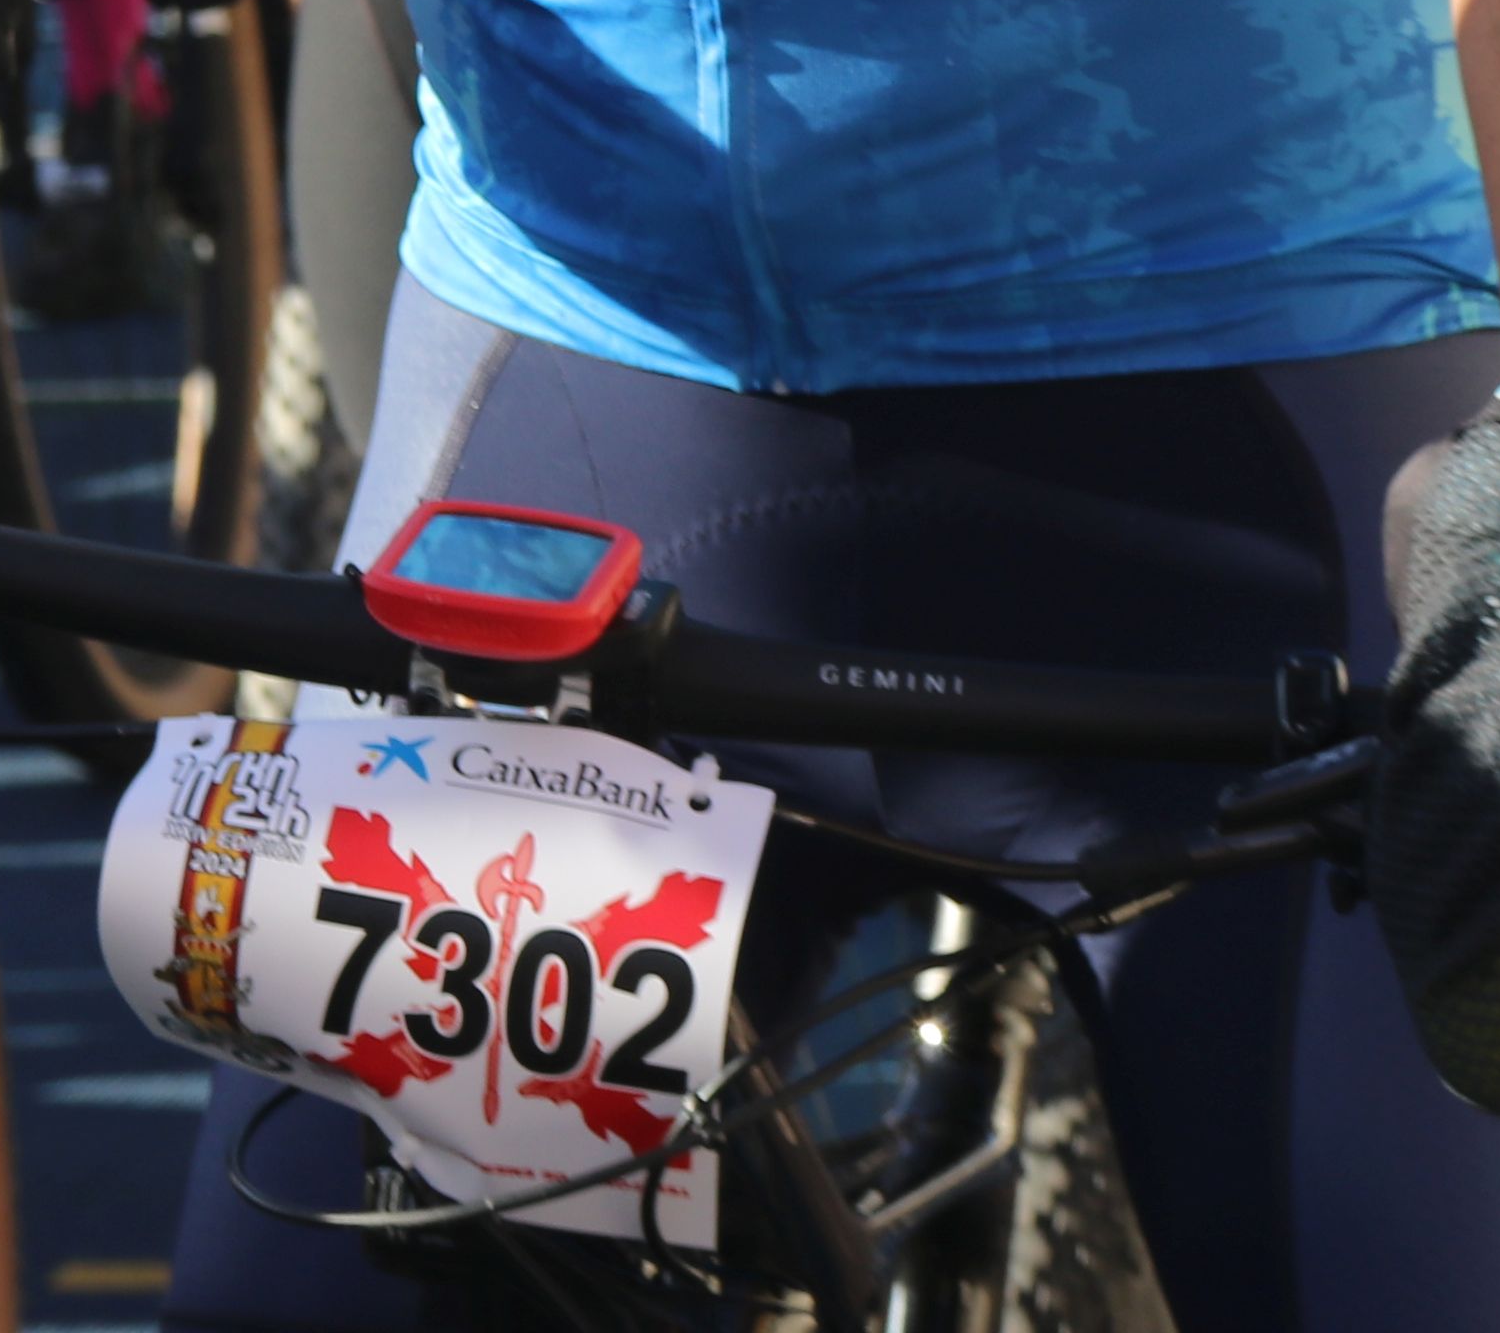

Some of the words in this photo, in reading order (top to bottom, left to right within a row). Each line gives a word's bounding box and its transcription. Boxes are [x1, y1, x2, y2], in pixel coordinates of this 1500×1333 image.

[819, 662, 970, 697] GEMINI
[449, 742, 677, 822] CaixaBank
[188, 848, 249, 881] 2024
[315, 886, 697, 1096] 7302
